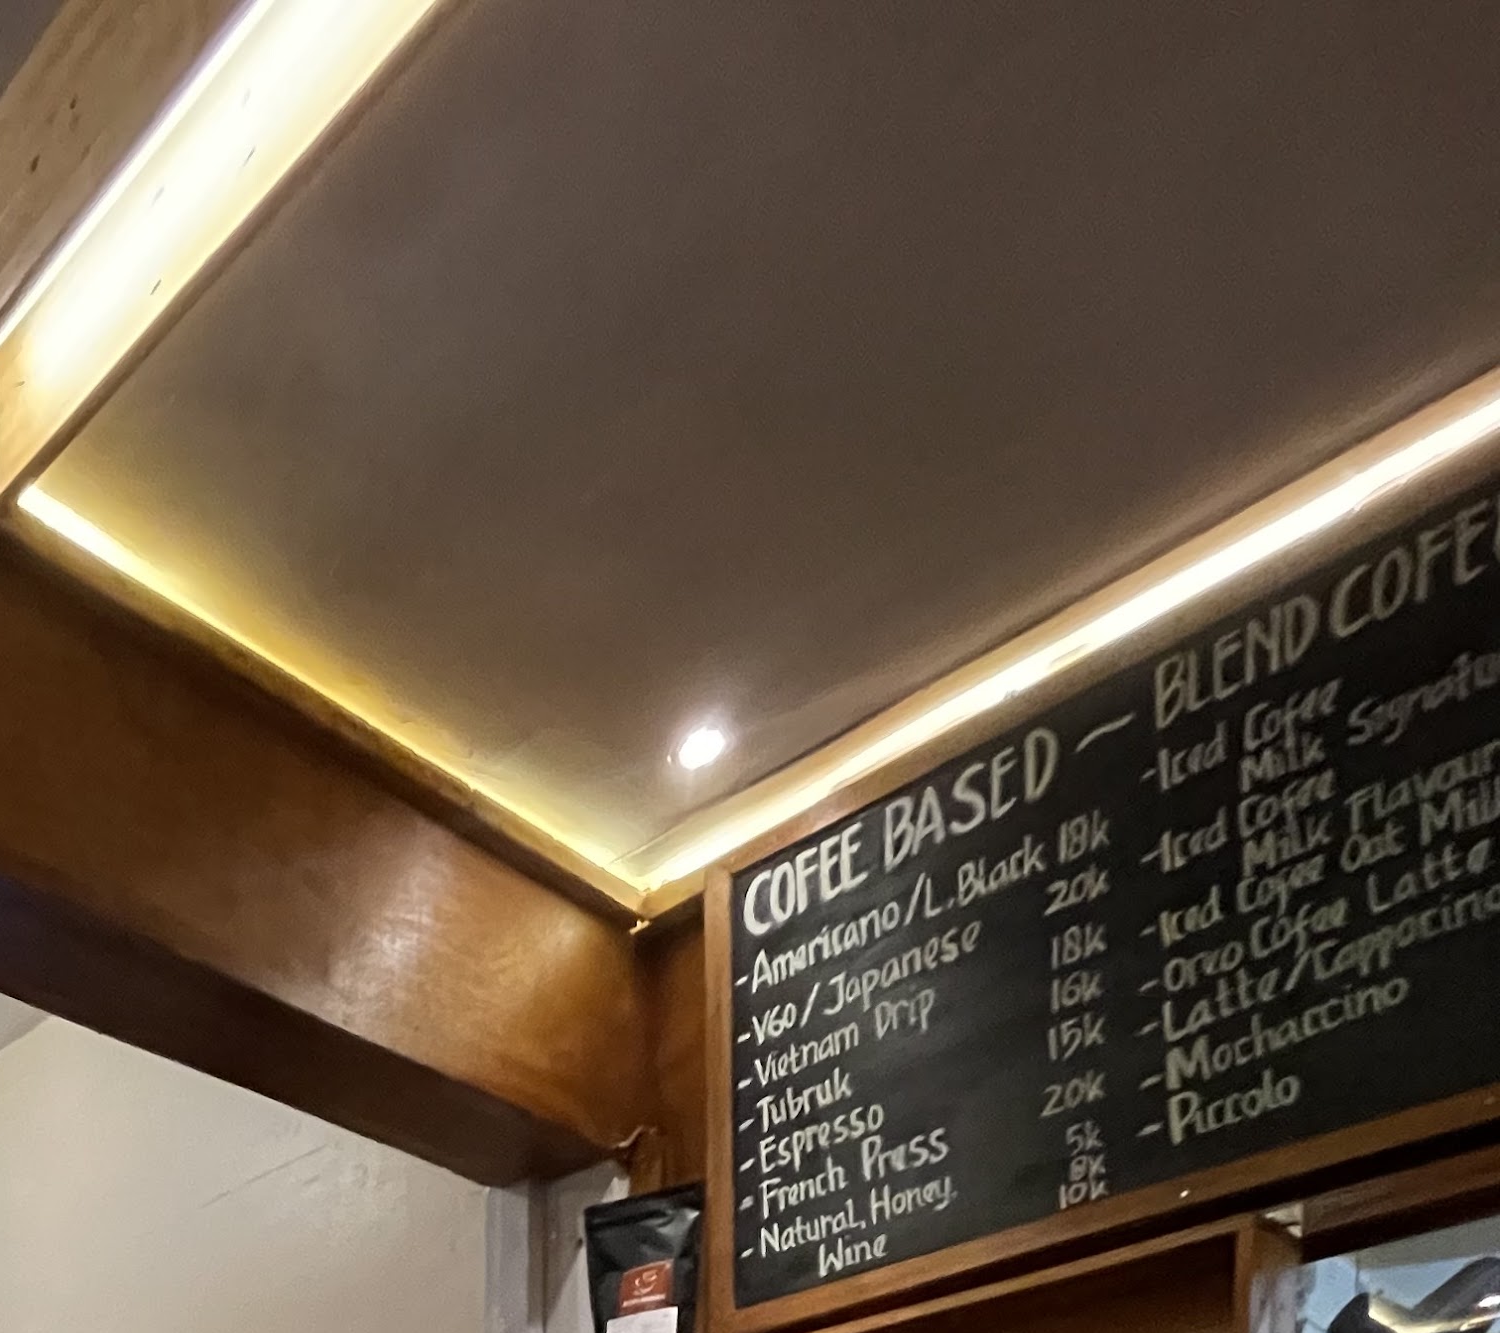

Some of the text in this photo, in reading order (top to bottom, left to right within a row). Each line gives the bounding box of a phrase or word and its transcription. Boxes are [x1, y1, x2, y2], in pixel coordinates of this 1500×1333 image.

[1154, 495, 1500, 731] BLEND COFE
[1158, 720, 1228, 791] Iced
[1239, 732, 1325, 794] Milk
[743, 727, 1058, 936] COFEE BASED
[1160, 805, 1228, 873] Iced
[1242, 812, 1333, 878] Milk
[957, 834, 1046, 907] Black
[1366, 837, 1491, 915] Latte
[1159, 884, 1224, 948] Iced
[754, 1022, 858, 1087] Vietnam
[874, 988, 935, 1039] Drip
[756, 1067, 852, 1133] Tubruk
[1167, 1067, 1301, 1147] Piccolo
[759, 1104, 884, 1173] Espresso
[759, 1156, 848, 1219] French
[861, 1127, 949, 1181] Press
[818, 1233, 889, 1278] Wine
